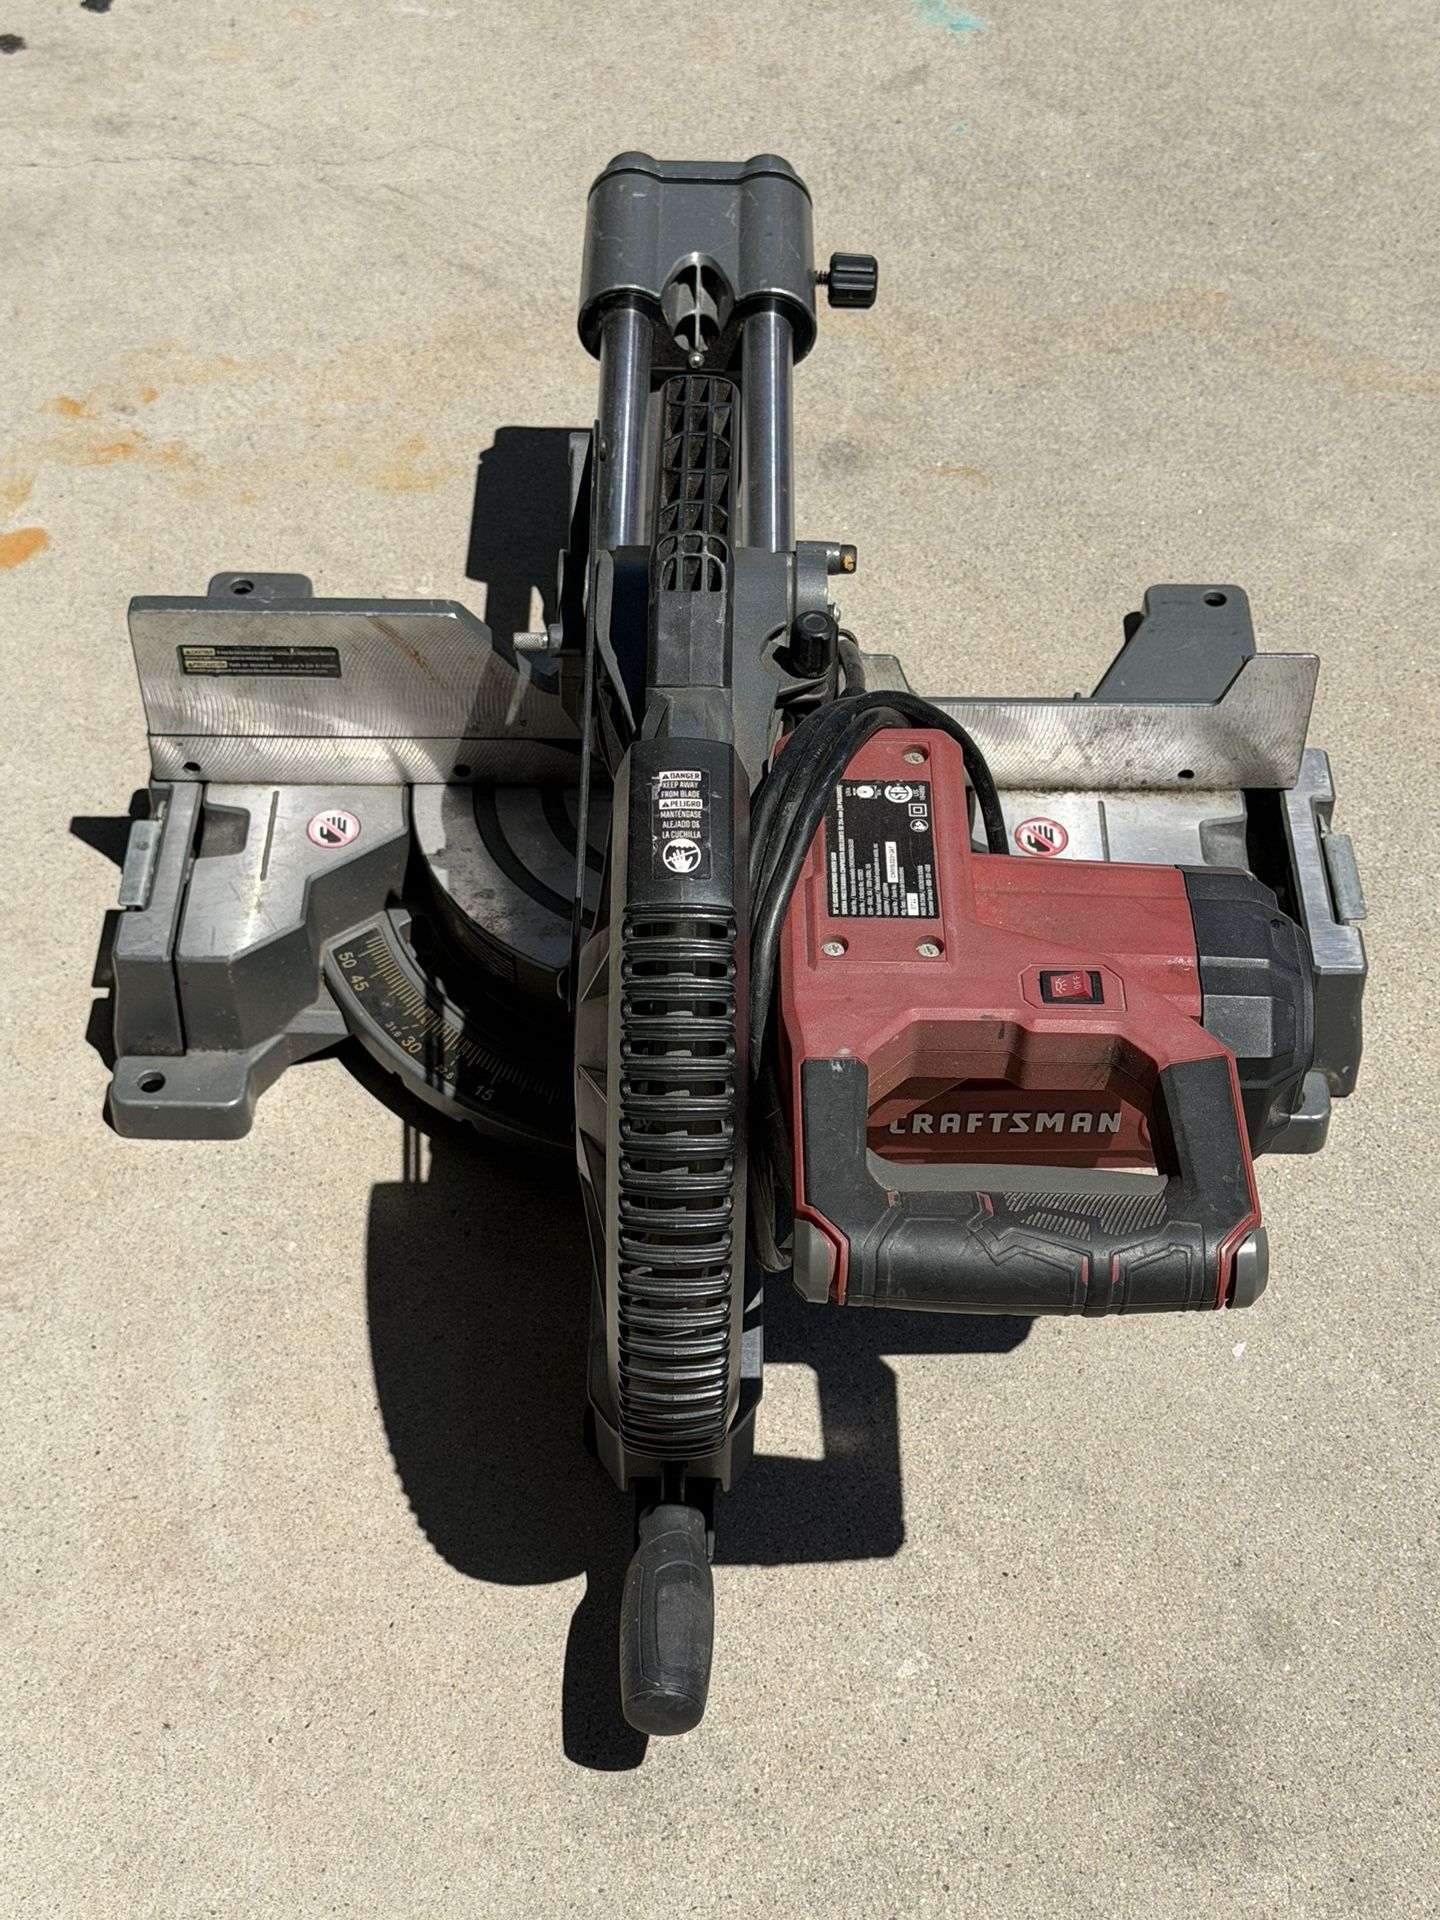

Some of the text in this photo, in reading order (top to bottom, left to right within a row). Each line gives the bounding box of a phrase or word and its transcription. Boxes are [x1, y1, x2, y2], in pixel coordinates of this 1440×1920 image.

[660, 809, 701, 818] MANTÉNGASE
[662, 820, 700, 828] ALEJADO DE
[338, 951, 356, 969] 50
[350, 974, 369, 992] 45
[1072, 975, 1082, 990] OFF
[401, 1035, 422, 1054] 30
[475, 1084, 495, 1101] 15
[889, 1112, 1122, 1134] CRAFTSMAN
